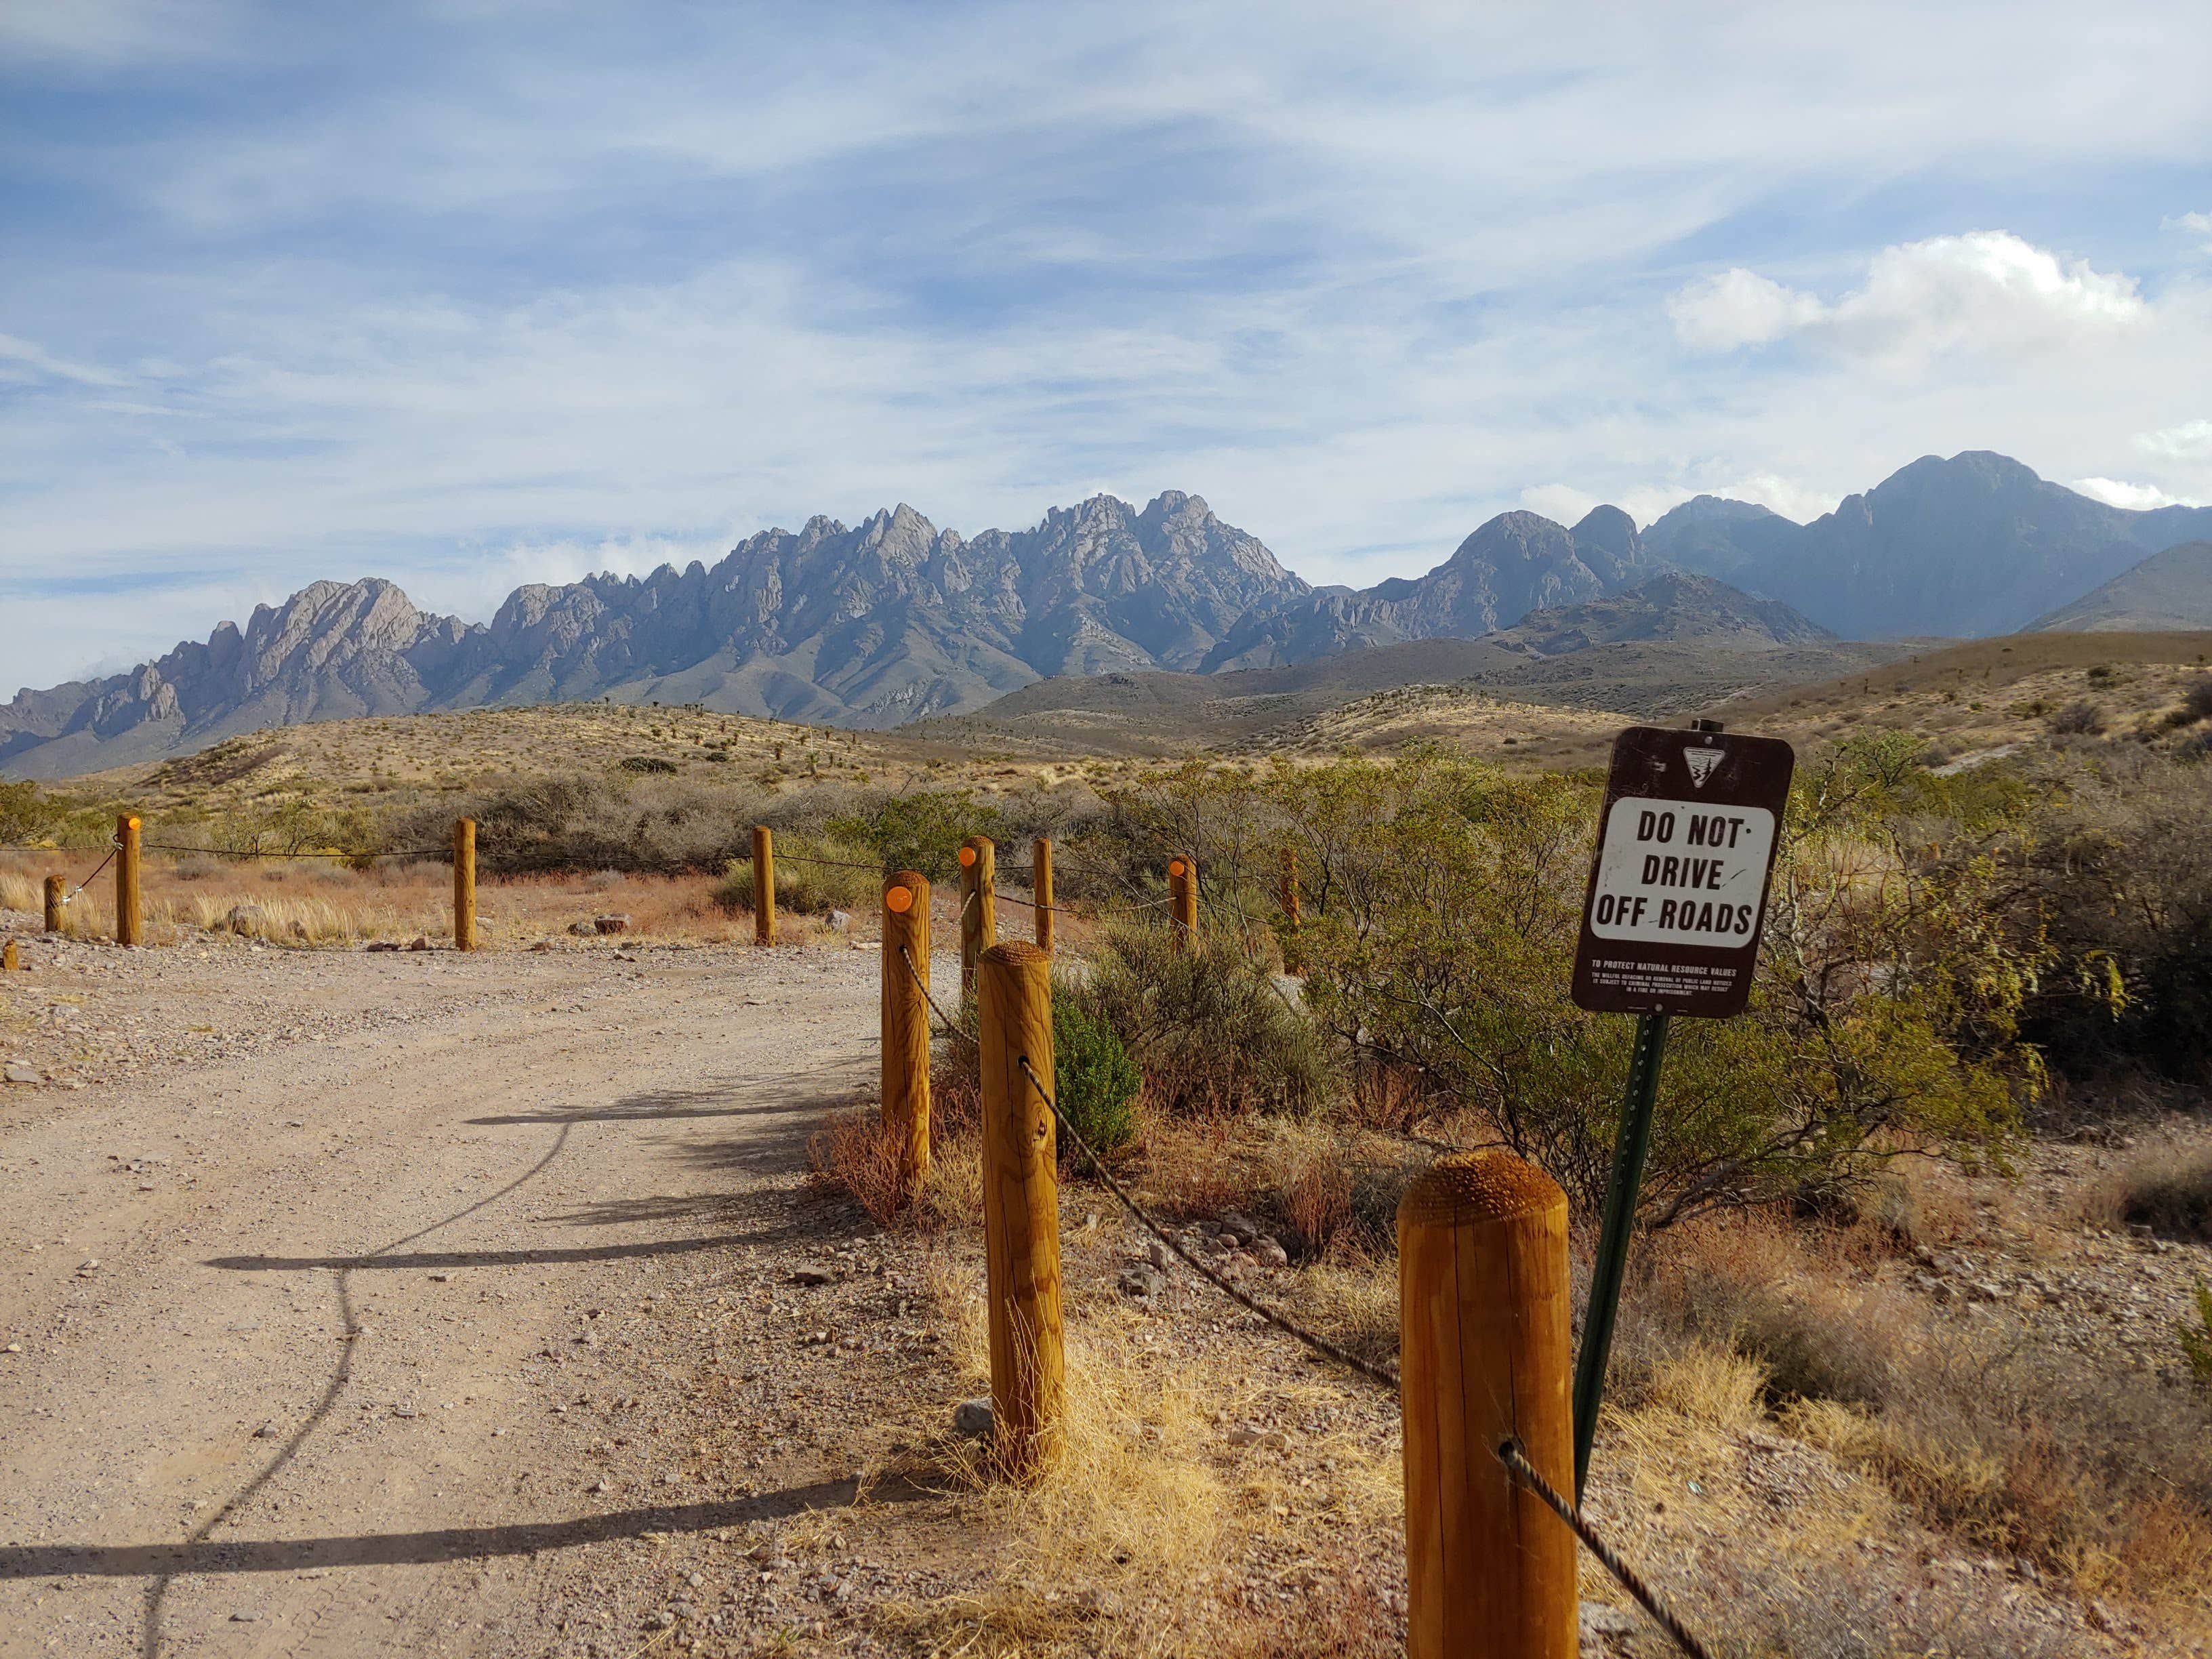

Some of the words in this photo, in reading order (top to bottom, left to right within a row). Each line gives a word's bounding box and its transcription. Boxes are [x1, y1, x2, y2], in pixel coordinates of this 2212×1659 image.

[1637, 810, 1675, 842] DO
[1687, 815, 1744, 848] NOT
[1641, 855, 1724, 890] DRIVE
[1597, 894, 1647, 927] OFF
[1658, 899, 1753, 935] ROADS
[1591, 959, 1601, 968] TO
[1603, 960, 1635, 970] PROTECT
[1637, 962, 1669, 972] NATURAL
[1671, 964, 1708, 975] RESOURCE
[1711, 968, 1737, 977] VALUES
